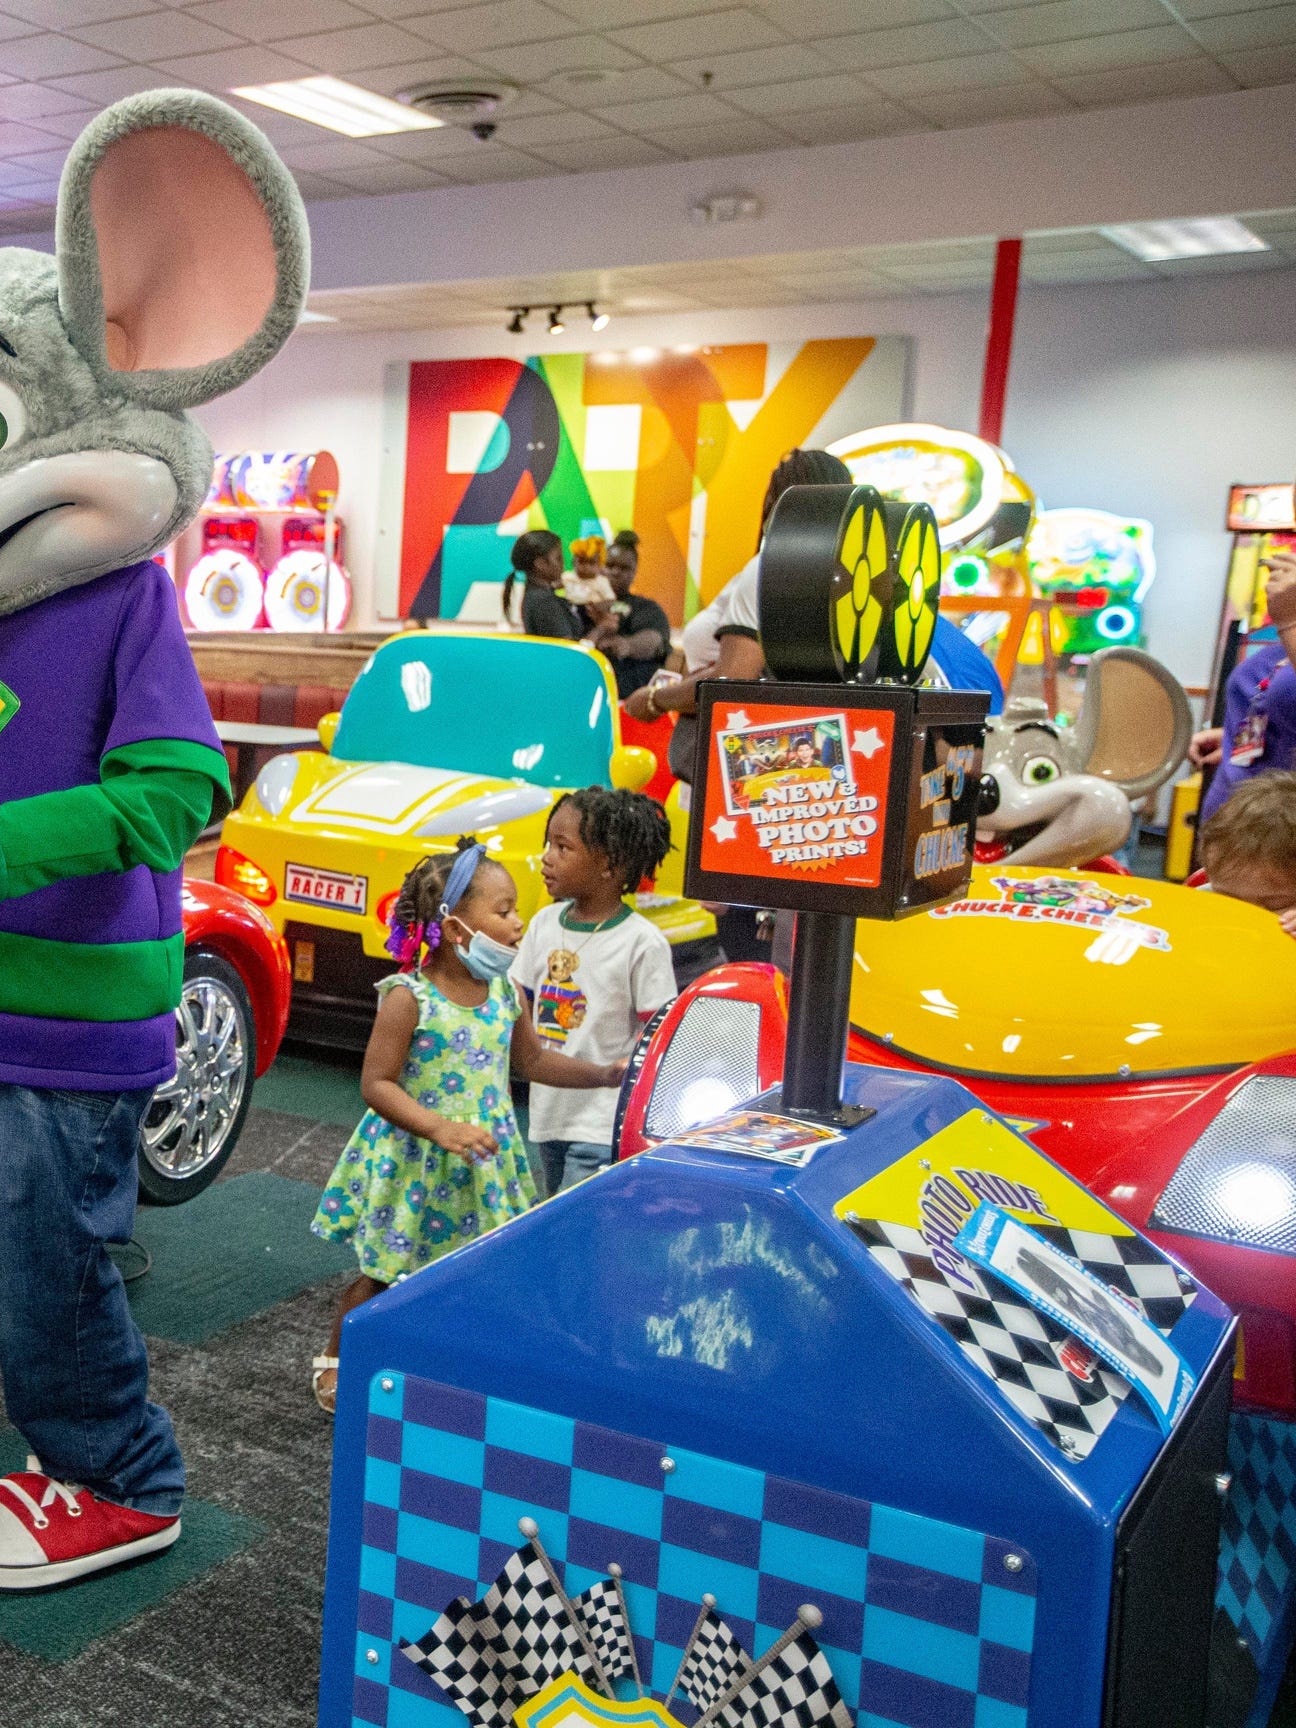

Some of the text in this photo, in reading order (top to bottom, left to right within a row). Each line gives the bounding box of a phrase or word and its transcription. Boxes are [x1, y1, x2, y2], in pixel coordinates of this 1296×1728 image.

[399, 336, 877, 630] PARTY
[763, 778, 841, 807] NEW
[751, 796, 878, 825] IMPROVED
[758, 815, 878, 848] PHOTO
[770, 839, 867, 864] PRINTS!
[291, 876, 362, 905] RACER 1
[919, 1174, 977, 1291] PHOTO
[952, 1168, 1059, 1224] RIDE
